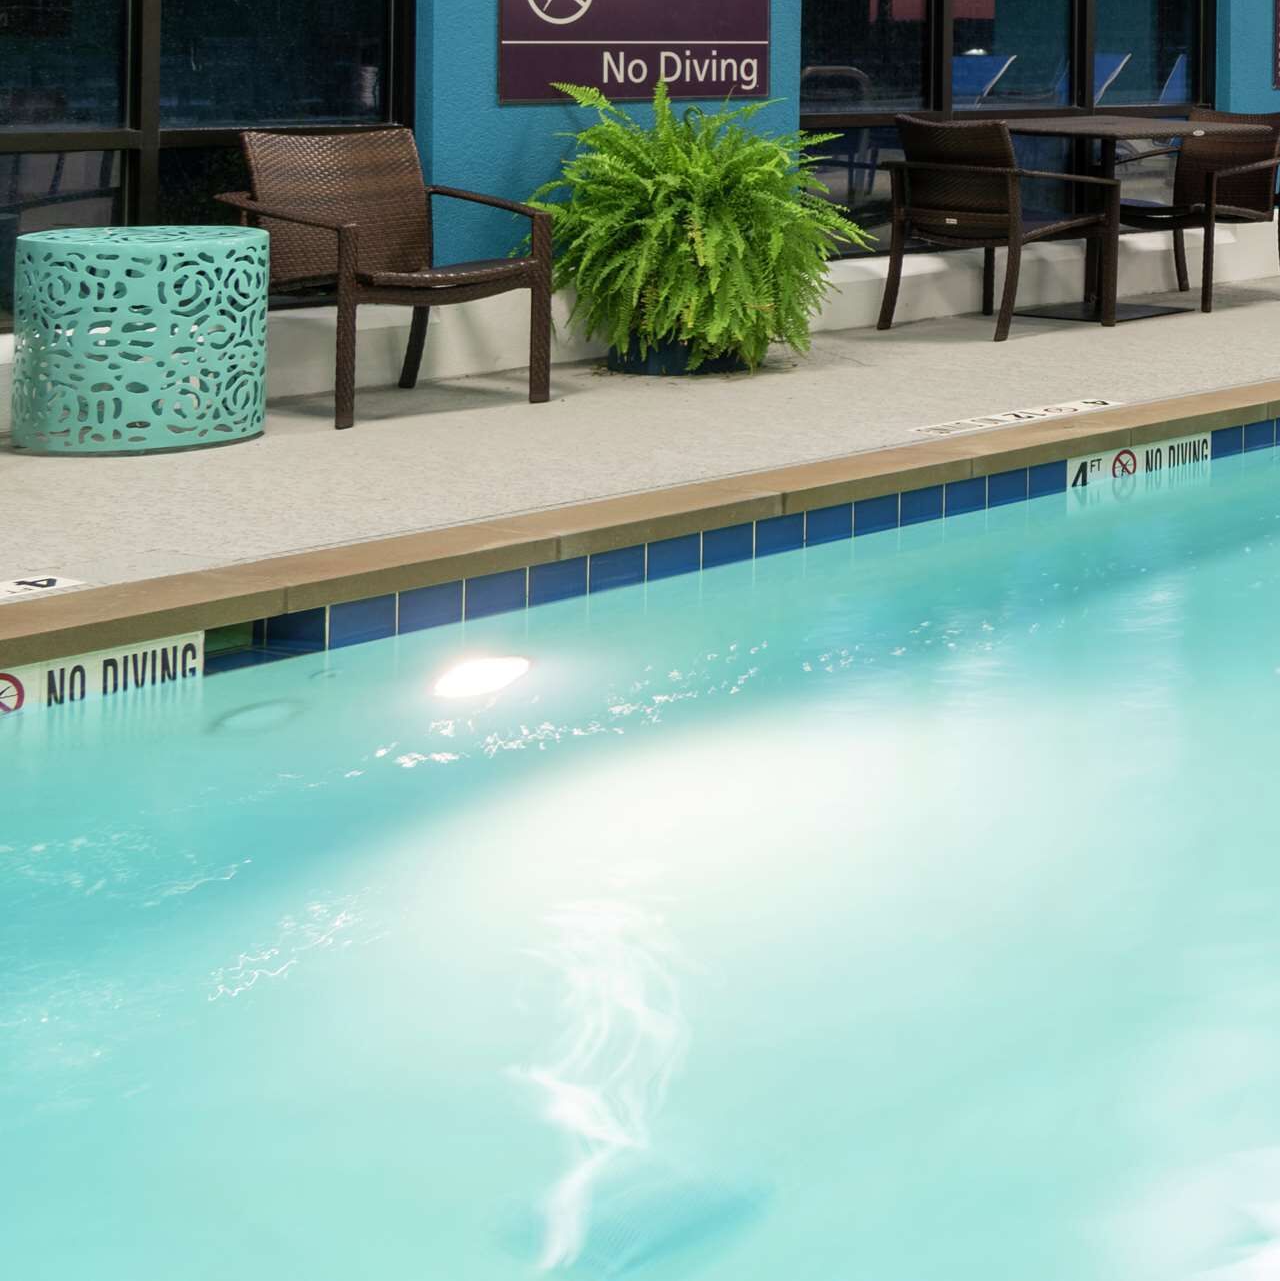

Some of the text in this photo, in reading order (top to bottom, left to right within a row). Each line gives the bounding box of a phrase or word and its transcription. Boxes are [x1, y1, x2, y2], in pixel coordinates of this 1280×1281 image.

[602, 50, 758, 90] No Diving
[1072, 439, 1209, 487] 4 FT NO DIVING
[47, 643, 197, 707] NO DIVING
